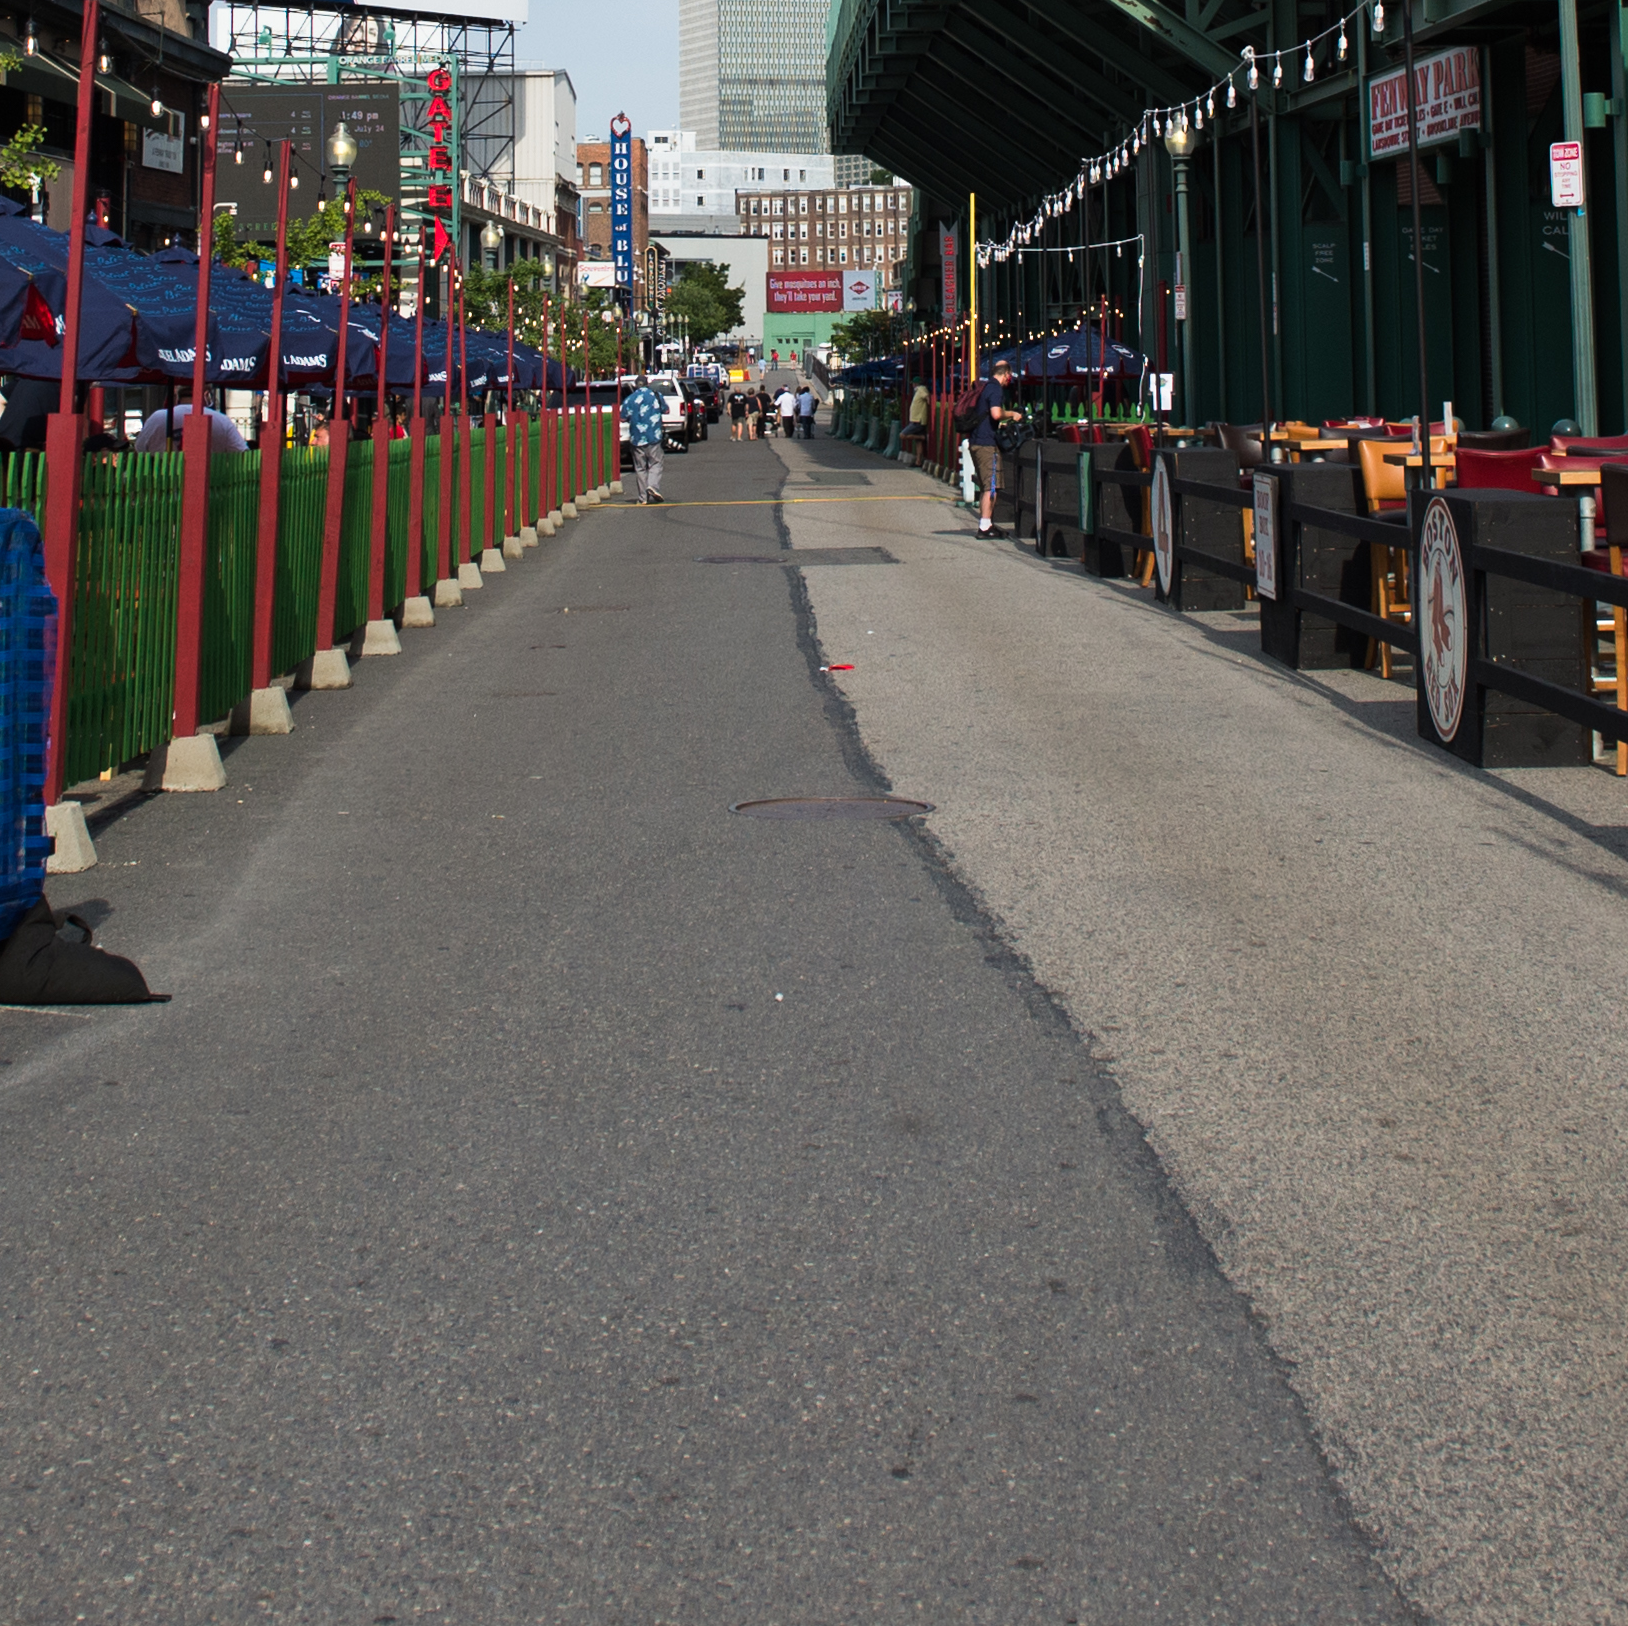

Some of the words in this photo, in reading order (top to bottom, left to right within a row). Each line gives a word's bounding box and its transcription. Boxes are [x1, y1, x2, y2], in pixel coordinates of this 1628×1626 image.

[339, 56, 380, 65] ORANGE
[382, 55, 417, 64] BARREL
[421, 54, 452, 64] MEDIA
[1433, 47, 1480, 101] PARK
[427, 67, 453, 170] GATE
[614, 142, 629, 216] HOUSE
[427, 184, 453, 208] E
[1544, 212, 1568, 220] WIL
[1542, 226, 1569, 235] CAL
[944, 235, 955, 256] BAR
[615, 239, 629, 283] BLU
[769, 278, 783, 289] Give
[944, 260, 956, 313] BLEACHER
[793, 290, 807, 302] take
[1422, 509, 1460, 587] BOSTON
